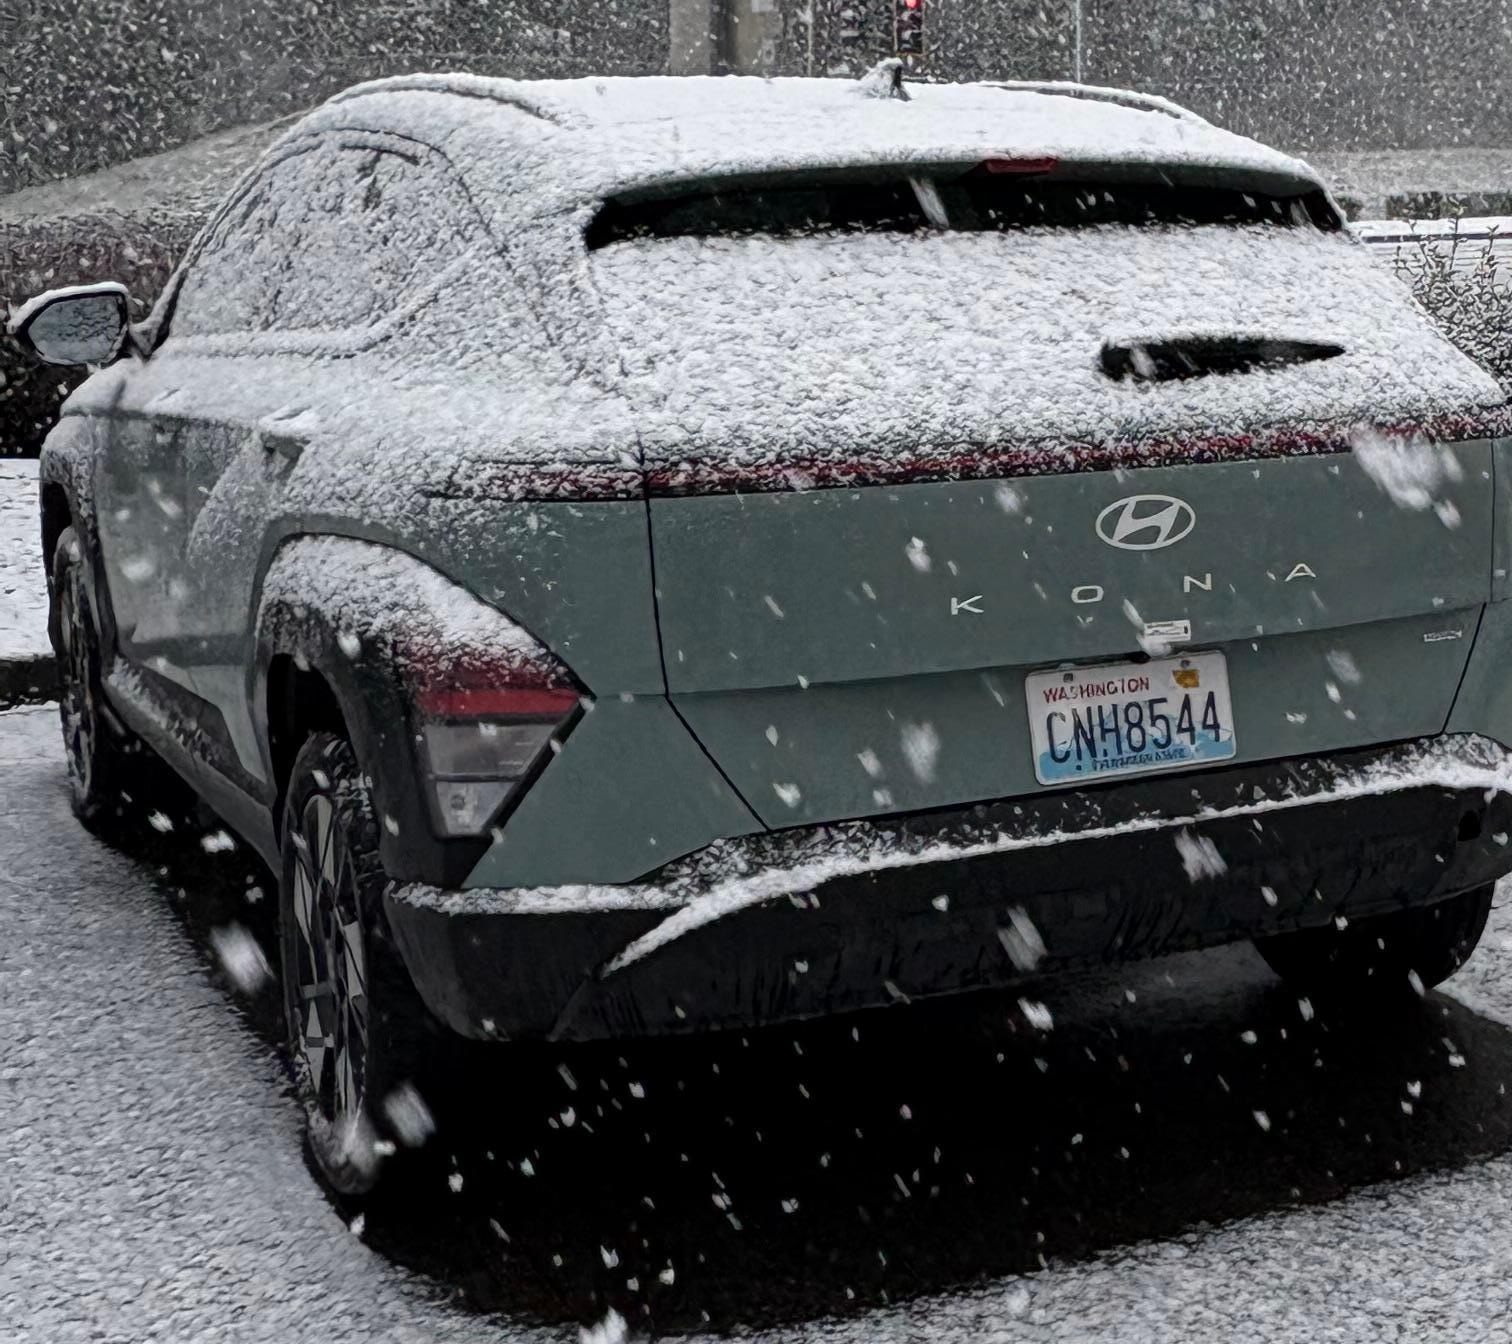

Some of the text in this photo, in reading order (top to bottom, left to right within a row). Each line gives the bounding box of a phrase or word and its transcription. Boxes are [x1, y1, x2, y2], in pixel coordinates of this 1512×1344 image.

[951, 563, 1316, 616] KONA
[1043, 676, 1150, 704] WASHINGTON
[1046, 690, 1221, 764] CNH8544
